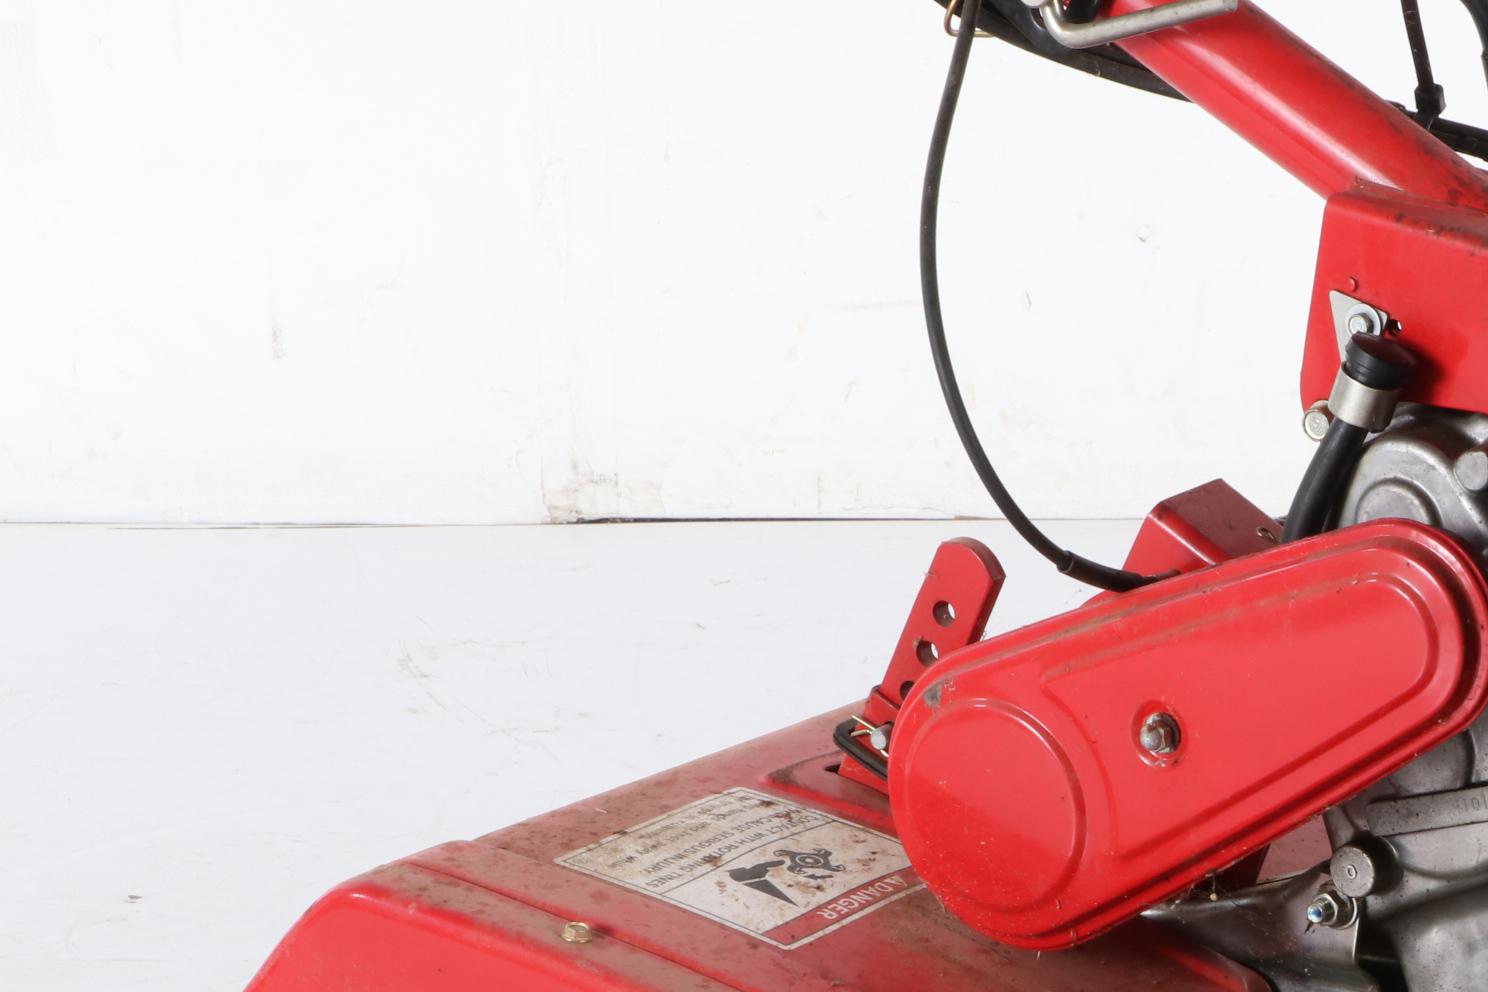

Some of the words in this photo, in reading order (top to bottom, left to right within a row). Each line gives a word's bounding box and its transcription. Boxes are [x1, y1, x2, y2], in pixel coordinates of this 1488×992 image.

[732, 817, 773, 833] CAUSE
[765, 814, 819, 836] CONTACT
[680, 831, 739, 854] SERIOUS
[736, 832, 769, 845] WITH
[645, 872, 685, 888] TINES
[816, 878, 899, 920] DANGER
